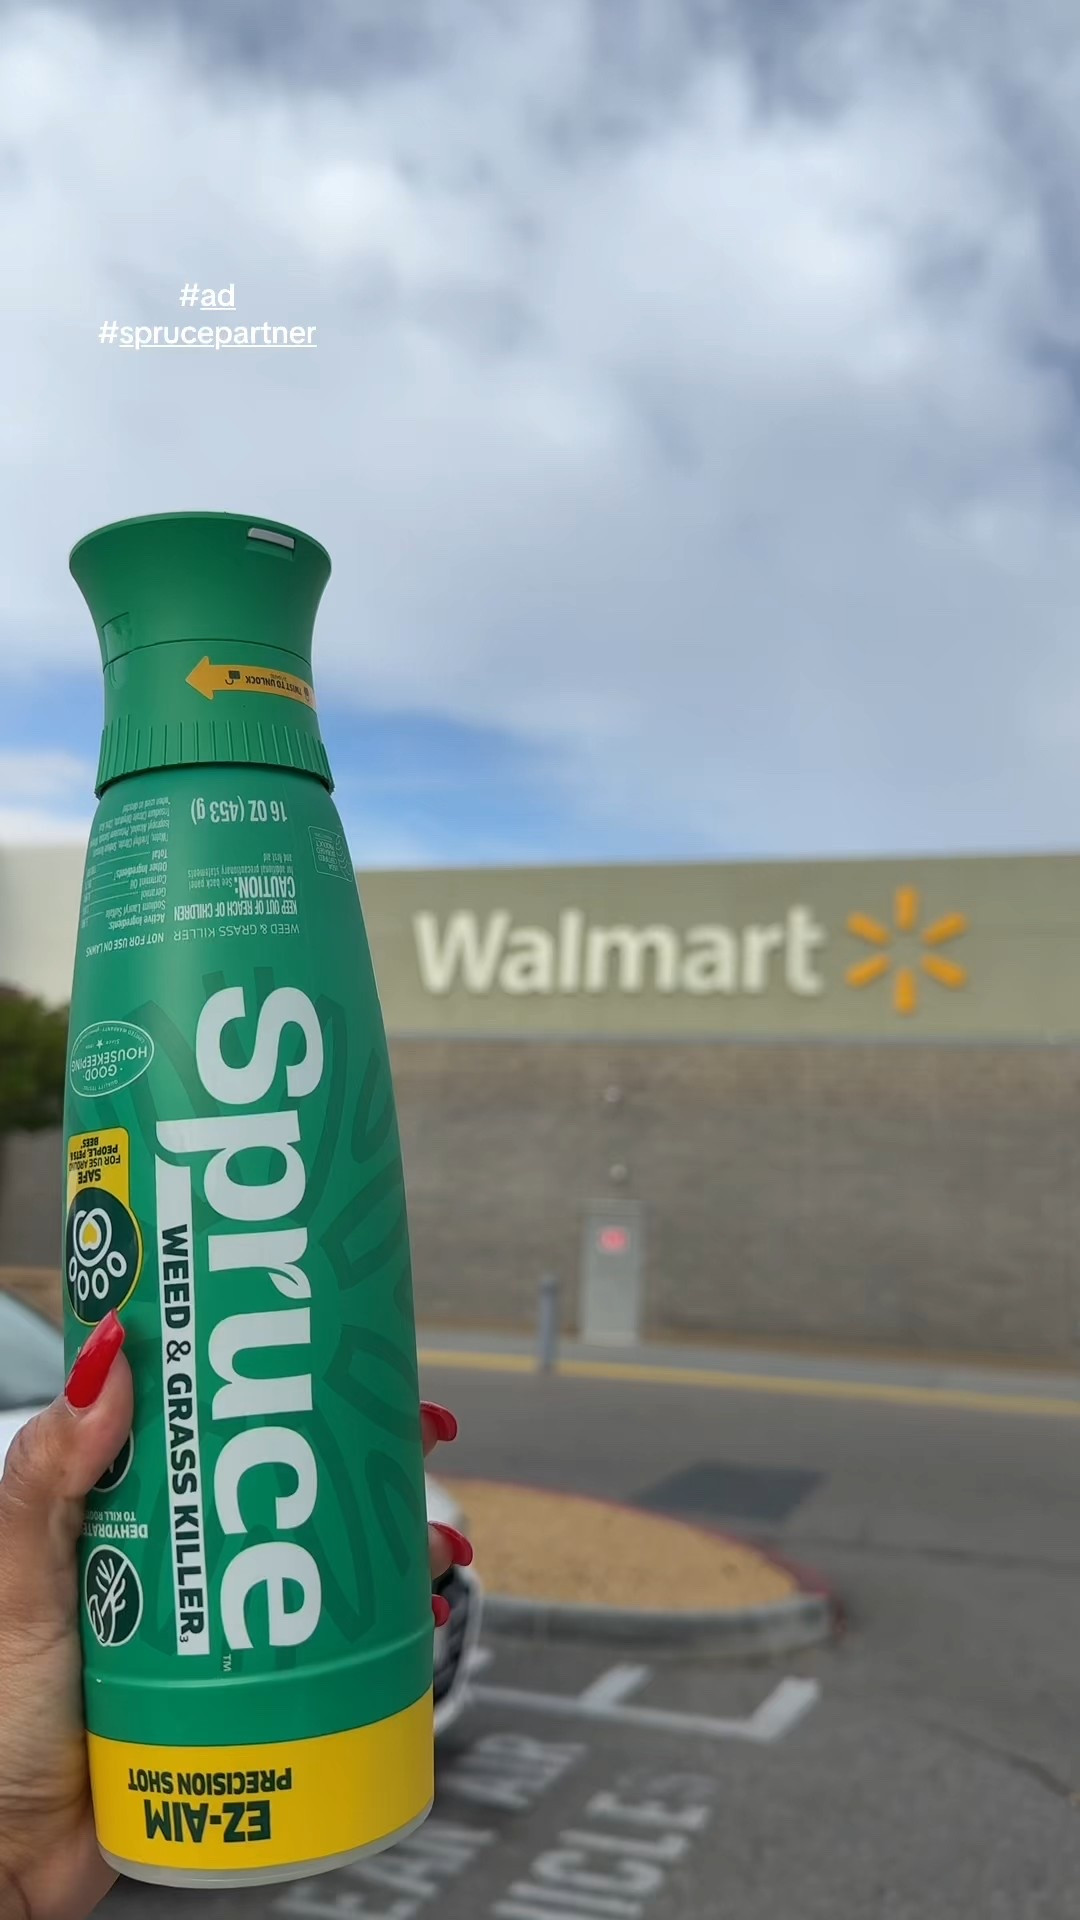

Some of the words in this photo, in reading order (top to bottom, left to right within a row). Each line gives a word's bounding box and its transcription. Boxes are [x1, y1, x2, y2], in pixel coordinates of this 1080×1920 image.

[245, 675, 276, 687] UNLOCK
[276, 680, 285, 689] TO
[286, 682, 302, 695] TWIST
[191, 798, 205, 825] g)
[209, 796, 244, 823] (453
[248, 800, 267, 821] OZ
[270, 801, 287, 822] 16
[152, 849, 168, 860] Total
[149, 862, 168, 872] Other
[222, 878, 232, 888] See
[234, 875, 296, 898] CAUTION:
[174, 902, 213, 921] CHILDREN
[215, 902, 225, 918] OF
[226, 900, 253, 917] REACH
[254, 900, 264, 916] OF
[266, 900, 280, 915] OUT
[281, 899, 297, 915] KEEP
[144, 913, 165, 924] Active
[174, 928, 215, 940] KILLER
[219, 924, 257, 936] GRASS
[260, 924, 268, 934] &
[270, 923, 300, 934] WEED
[114, 938, 128, 950] USE
[128, 934, 145, 947] FOR
[147, 932, 164, 944] NOT
[103, 940, 113, 953] ON
[412, 905, 826, 996] Walmart
[71, 1045, 148, 1072] HOUSEKEEPING
[84, 1064, 117, 1081] GOOD
[87, 1144, 118, 1158] PEOPLE,
[89, 1157, 102, 1168] USE
[104, 1154, 120, 1166] FOR
[78, 1168, 101, 1184] SAFE
[161, 1224, 191, 1329] WEED
[166, 1340, 192, 1365] &
[167, 1372, 198, 1496] GRASS
[104, 1510, 122, 1521] KILL
[124, 1511, 136, 1521] TO
[128, 1768, 174, 1794] SHOT
[177, 1768, 292, 1795] PRECISION
[144, 1799, 272, 1843] EZ-AIM
